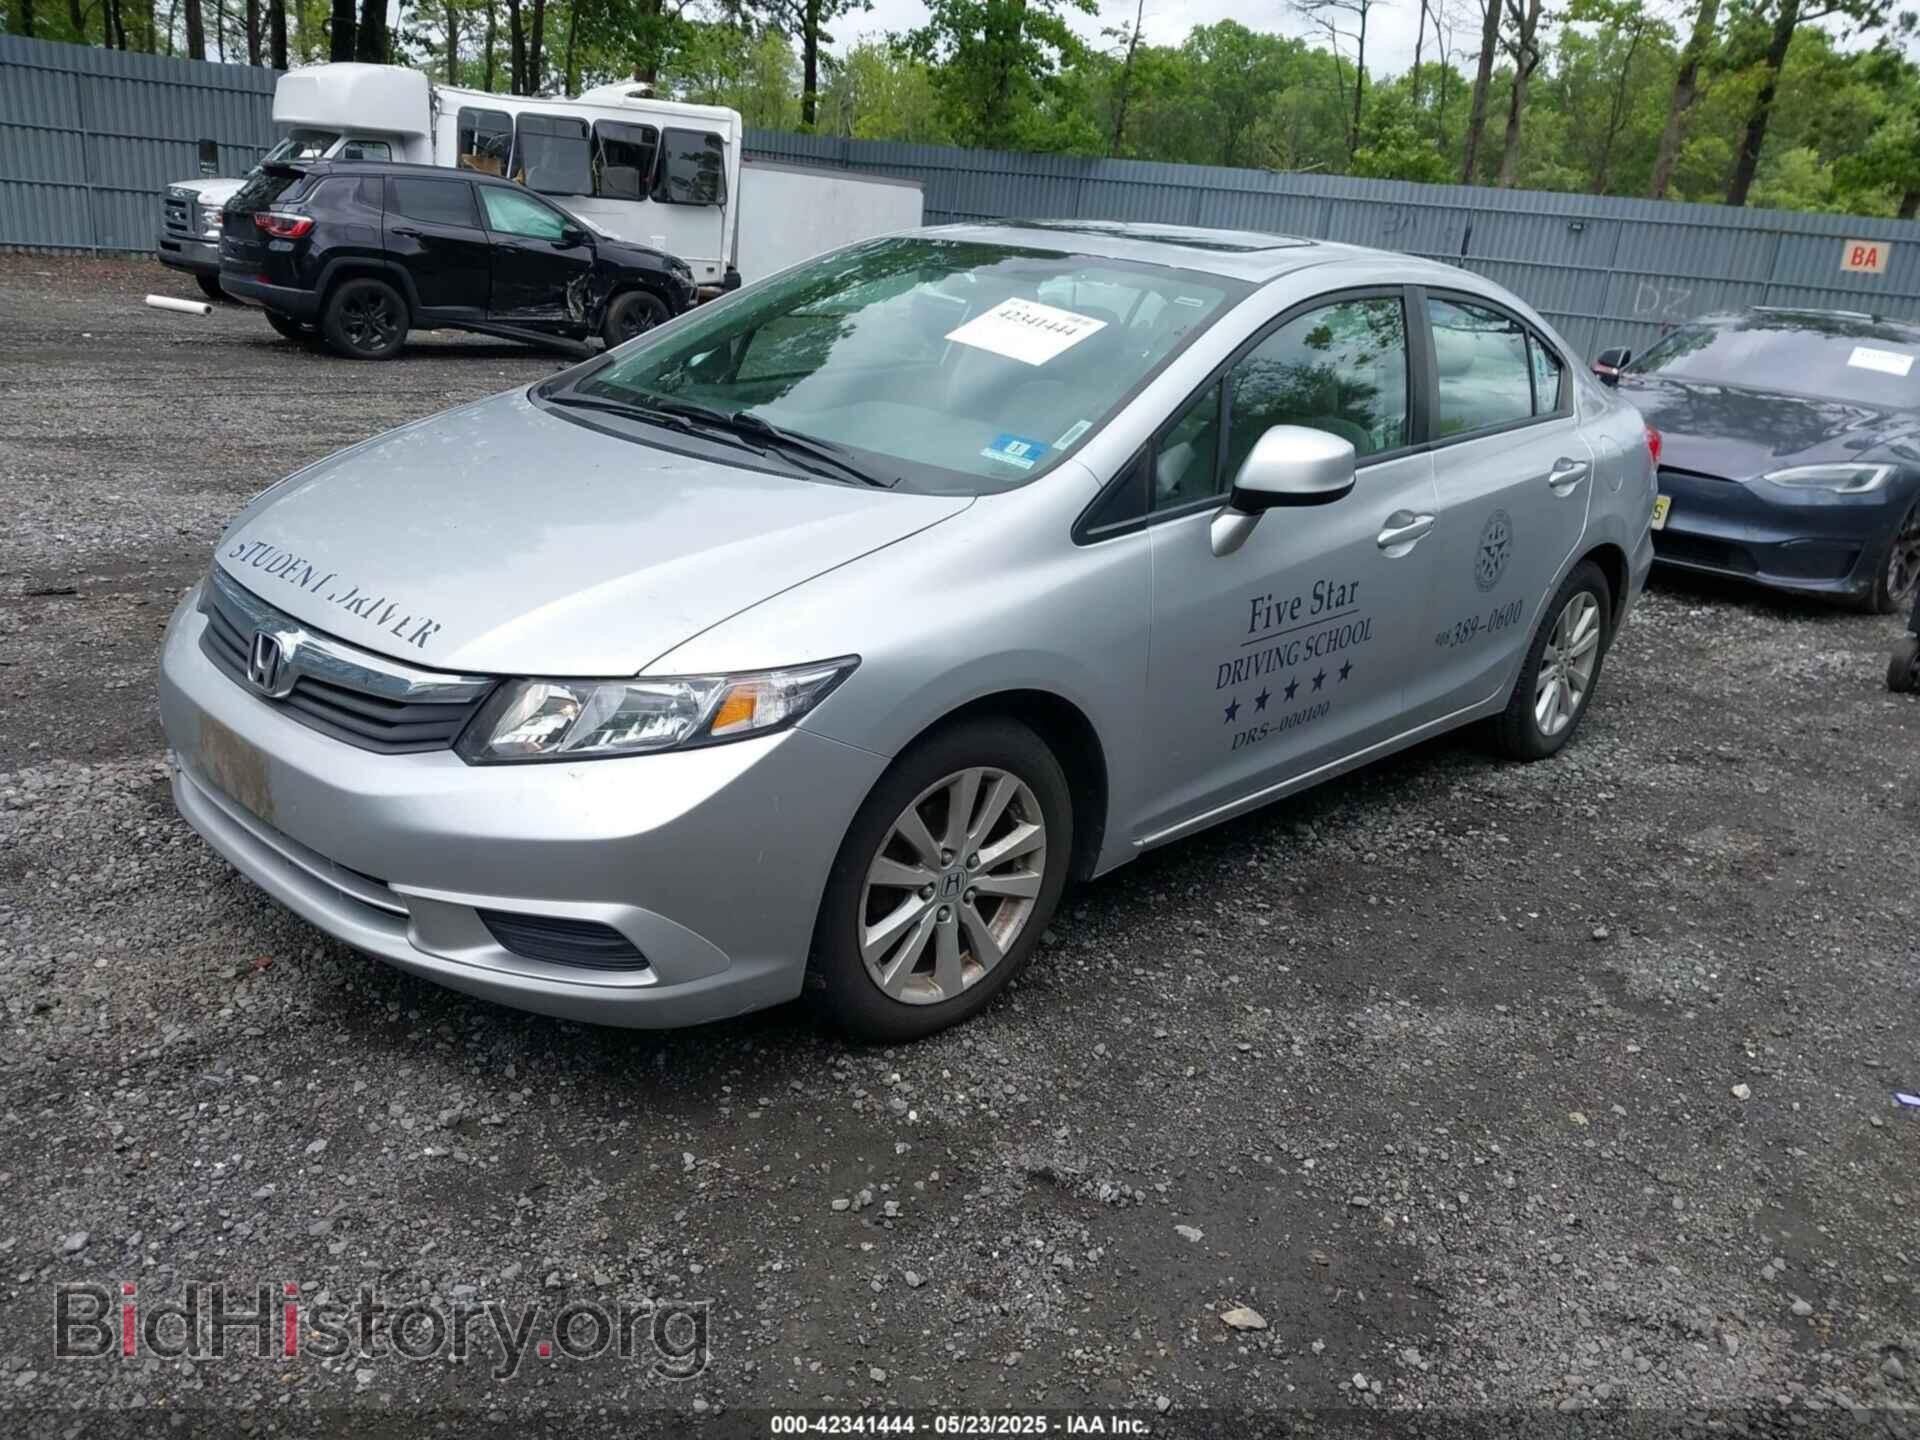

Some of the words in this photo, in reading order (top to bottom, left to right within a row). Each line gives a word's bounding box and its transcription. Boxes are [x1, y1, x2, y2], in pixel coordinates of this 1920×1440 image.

[1850, 246, 1878, 268] BA
[999, 310, 1078, 336] 42341444
[229, 541, 338, 592] STUDENT
[1248, 594, 1302, 634] Five
[1310, 579, 1360, 615] Star
[1216, 640, 1302, 690] DRIVING
[1302, 616, 1374, 662] SCHOOL
[1231, 700, 1331, 751] DRS-000100
